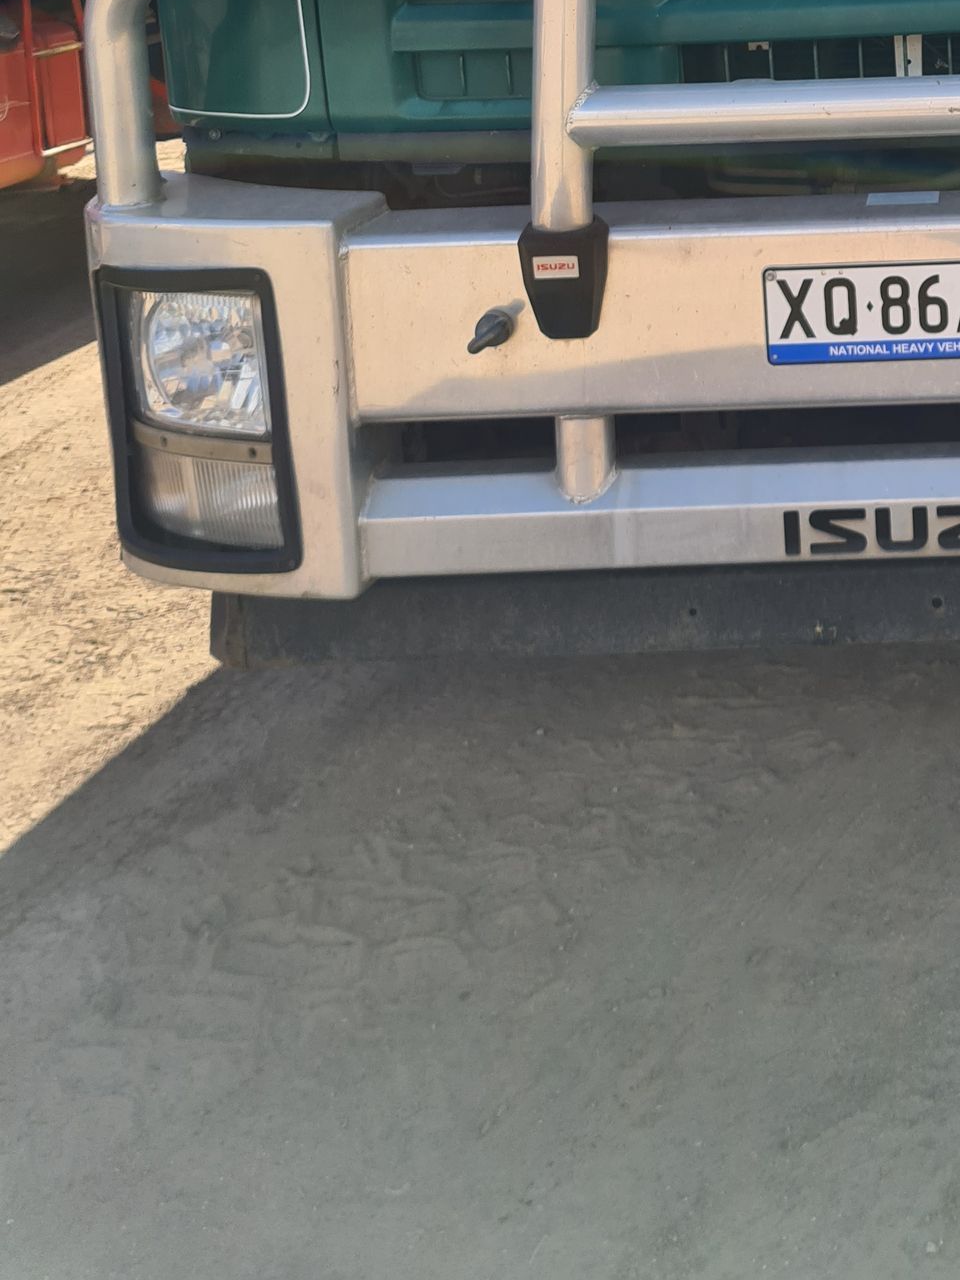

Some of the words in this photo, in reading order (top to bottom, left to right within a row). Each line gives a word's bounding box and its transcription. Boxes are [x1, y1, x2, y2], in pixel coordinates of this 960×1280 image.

[536, 262, 576, 271] ISUZU
[829, 343, 890, 356] NATIONAL
[892, 341, 935, 354] HEAVY
